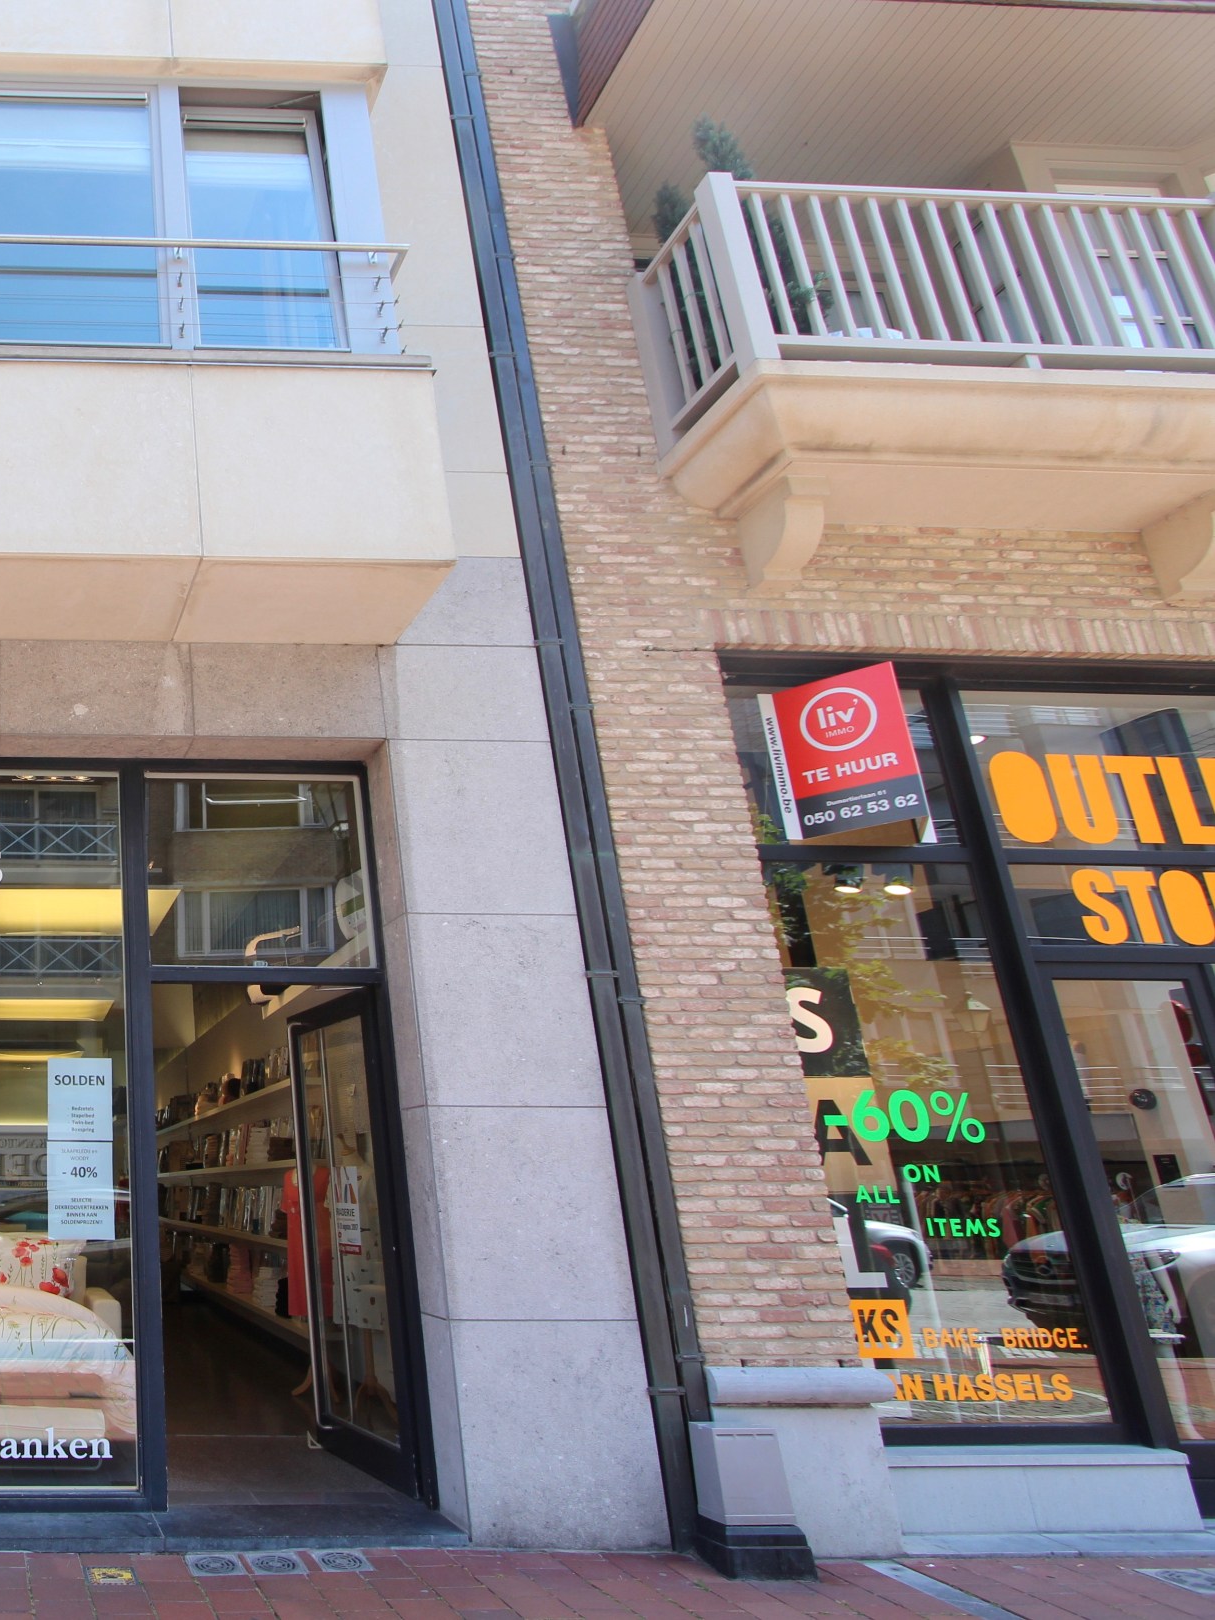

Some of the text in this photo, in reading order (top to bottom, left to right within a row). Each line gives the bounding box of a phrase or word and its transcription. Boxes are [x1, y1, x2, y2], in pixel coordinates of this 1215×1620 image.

[825, 725, 855, 739] IMMO
[766, 716, 793, 815] www.livimmo.be
[802, 752, 899, 785] TE HUUR
[804, 793, 919, 826] 050 62 53 62
[989, 751, 1215, 844] OUTL
[1071, 869, 1215, 946] STO
[54, 1074, 105, 1086] SOLDEN
[823, 1089, 986, 1144] -60%
[70, 1166, 98, 1178] 40%
[903, 1164, 942, 1183] ON
[856, 1184, 900, 1204] ALL
[925, 1217, 1002, 1238] ITEMS
[931, 1373, 1074, 1402] HASSELS
